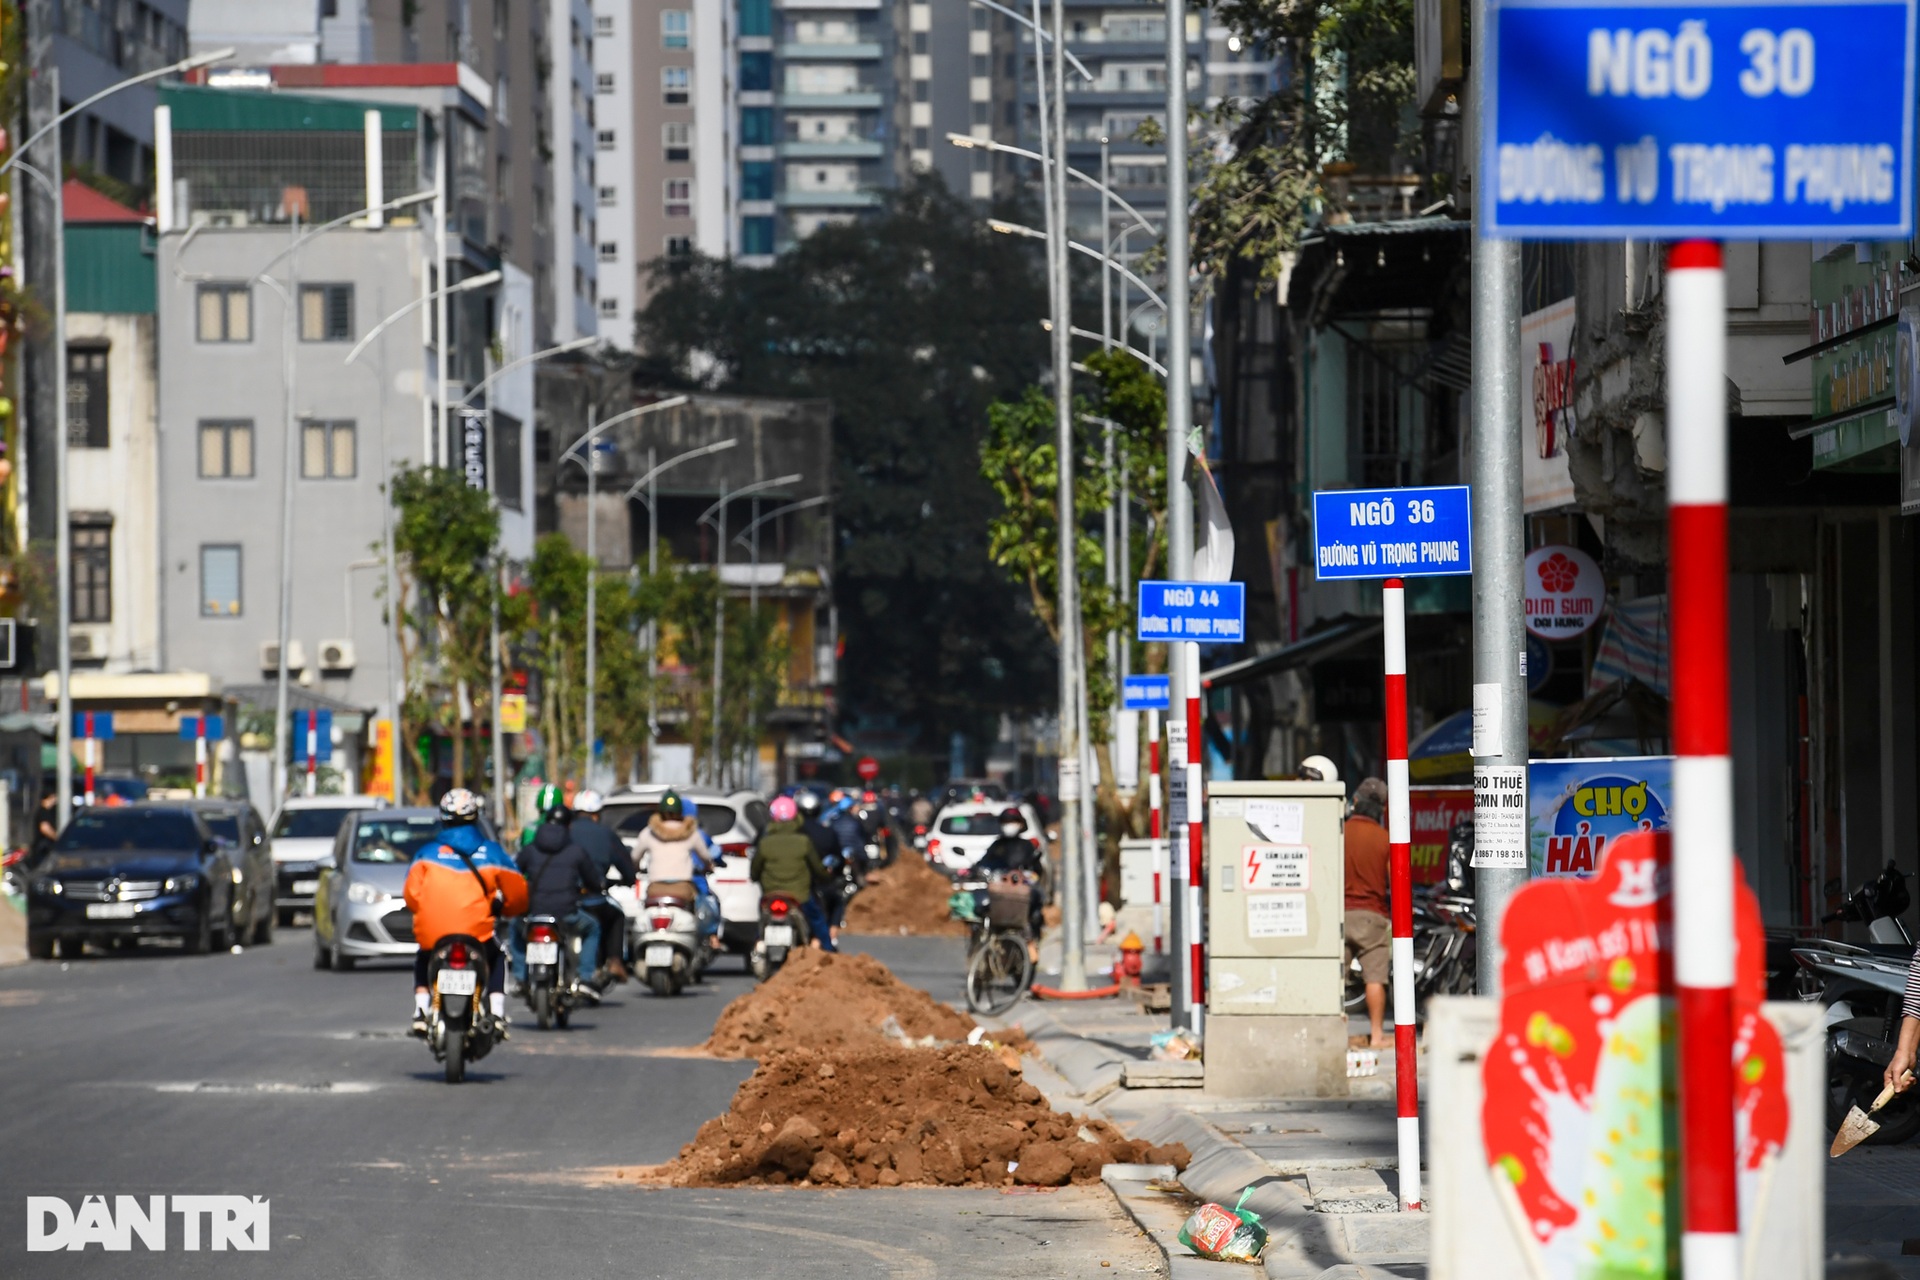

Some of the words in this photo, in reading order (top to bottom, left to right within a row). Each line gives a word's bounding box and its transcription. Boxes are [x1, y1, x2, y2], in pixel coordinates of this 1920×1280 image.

[1586, 19, 1713, 99] NGÕ
[1739, 27, 1815, 97] 30
[1614, 133, 1659, 204] VŨ
[1669, 142, 1775, 214] TRỌNG
[1783, 142, 1895, 214] PHỤNG
[1350, 497, 1395, 526] NGÕ
[1408, 499, 1435, 524] 36
[1320, 540, 1358, 567] ĐƯỜNG
[1361, 541, 1377, 565] VŨ
[1380, 542, 1417, 567] TRỌNG
[1420, 540, 1459, 565] PHỤNG
[1163, 586, 1195, 607] NGÕ
[1199, 589, 1219, 607] 44
[1525, 598, 1555, 615] DIM
[1562, 598, 1593, 615] SUM
[1474, 776, 1488, 789] CHO
[1493, 774, 1522, 789] THUÊ
[1503, 790, 1523, 808] MỚI
[1573, 780, 1647, 822] CHỢ
[1496, 850, 1510, 858] 198
[1546, 822, 1605, 872] HẢI
